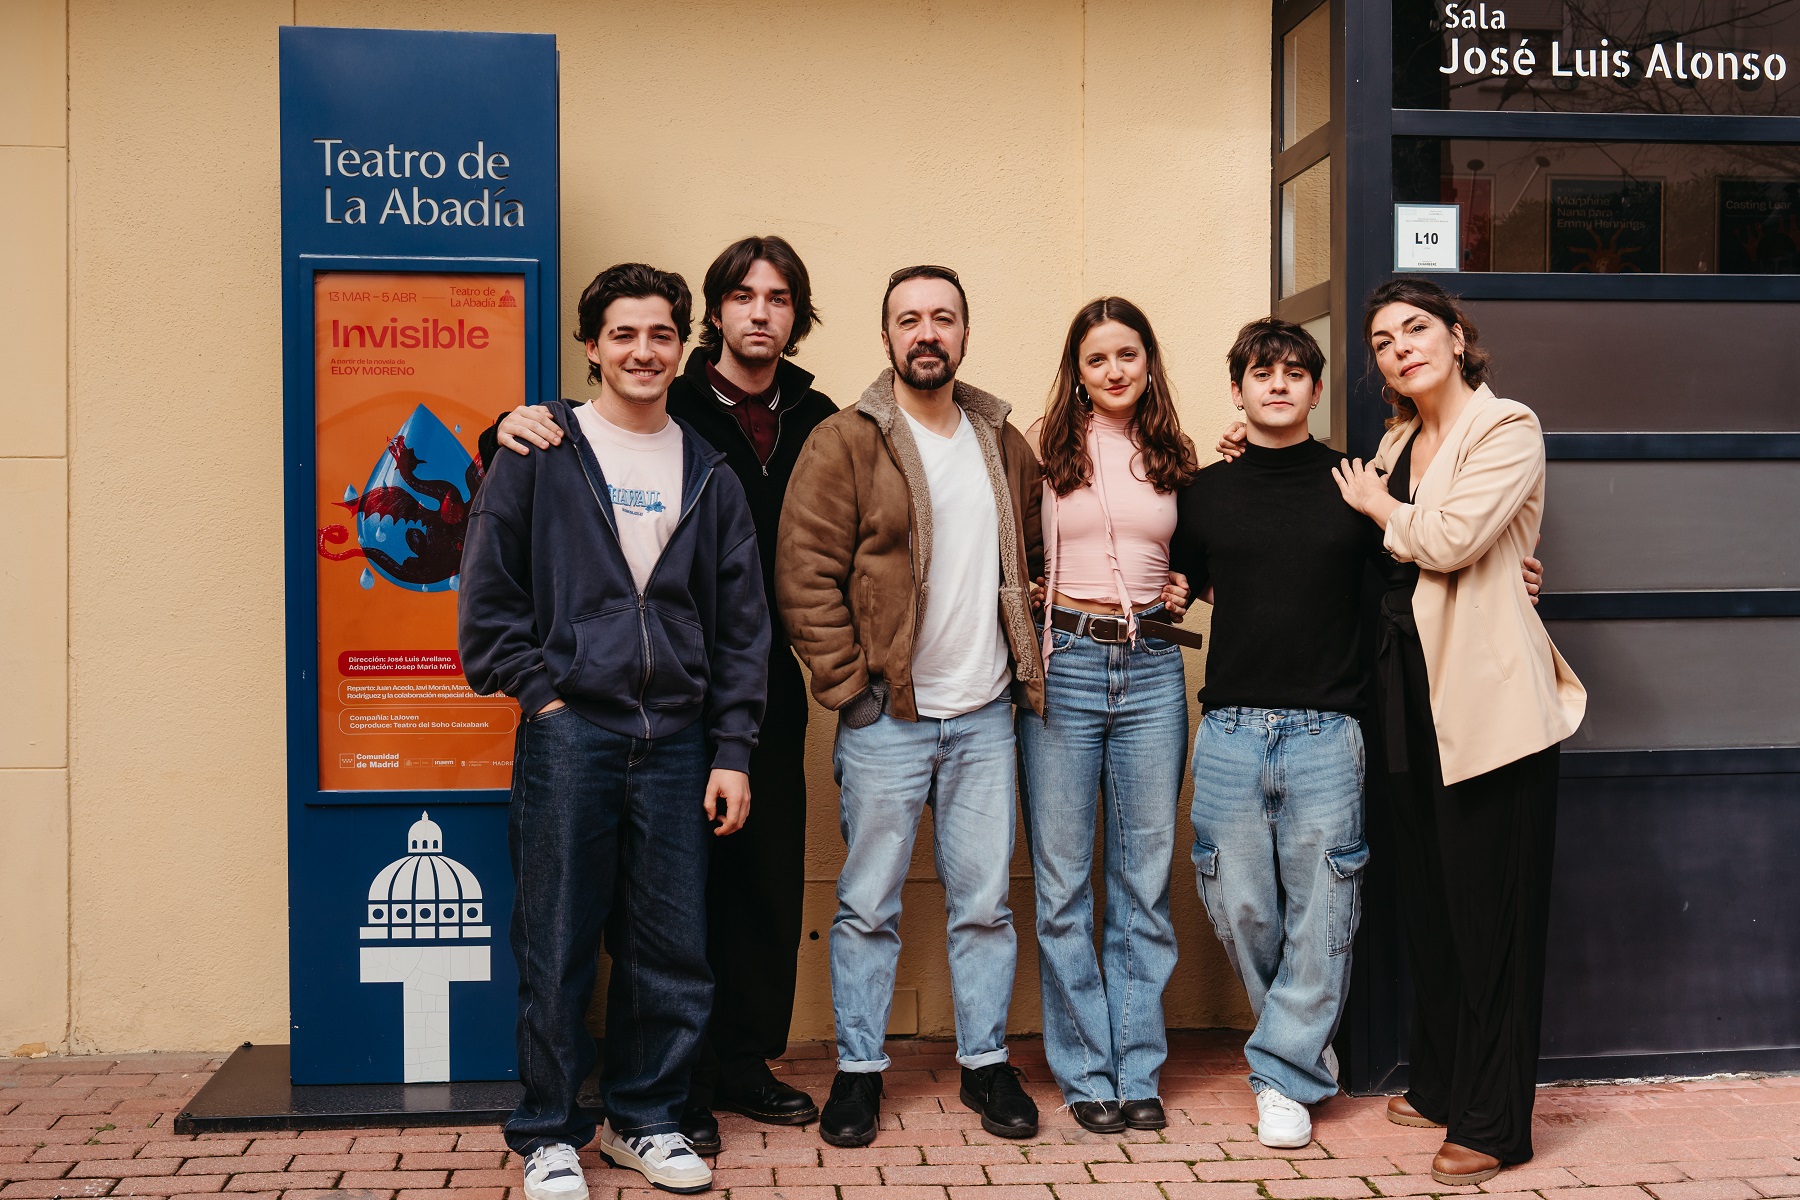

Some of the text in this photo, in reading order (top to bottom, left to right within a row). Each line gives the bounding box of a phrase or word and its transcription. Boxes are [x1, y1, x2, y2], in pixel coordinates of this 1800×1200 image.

[1445, 2, 1506, 30] Sala
[1439, 38, 1787, 81] José Luis Alonso
[313, 138, 510, 180] Teatro de
[325, 186, 525, 227] La Abadía
[1725, 200, 1792, 211] Casting Lear
[1556, 208, 1613, 218] Nana para
[1556, 219, 1646, 230] Emmy Hennings
[1415, 232, 1439, 245] L10
[449, 286, 496, 296] Teatro de
[328, 291, 340, 302] 13
[342, 292, 371, 302] MAR
[382, 292, 390, 303] 5
[391, 292, 417, 303] ABR
[450, 298, 496, 308] La Abadía
[332, 317, 490, 350] Invisible
[337, 358, 356, 366] partir
[331, 366, 415, 376] ELOY MORENO
[346, 692, 382, 700] Rodríguez
[437, 691, 465, 699] especial
[369, 760, 399, 768] Madrid
